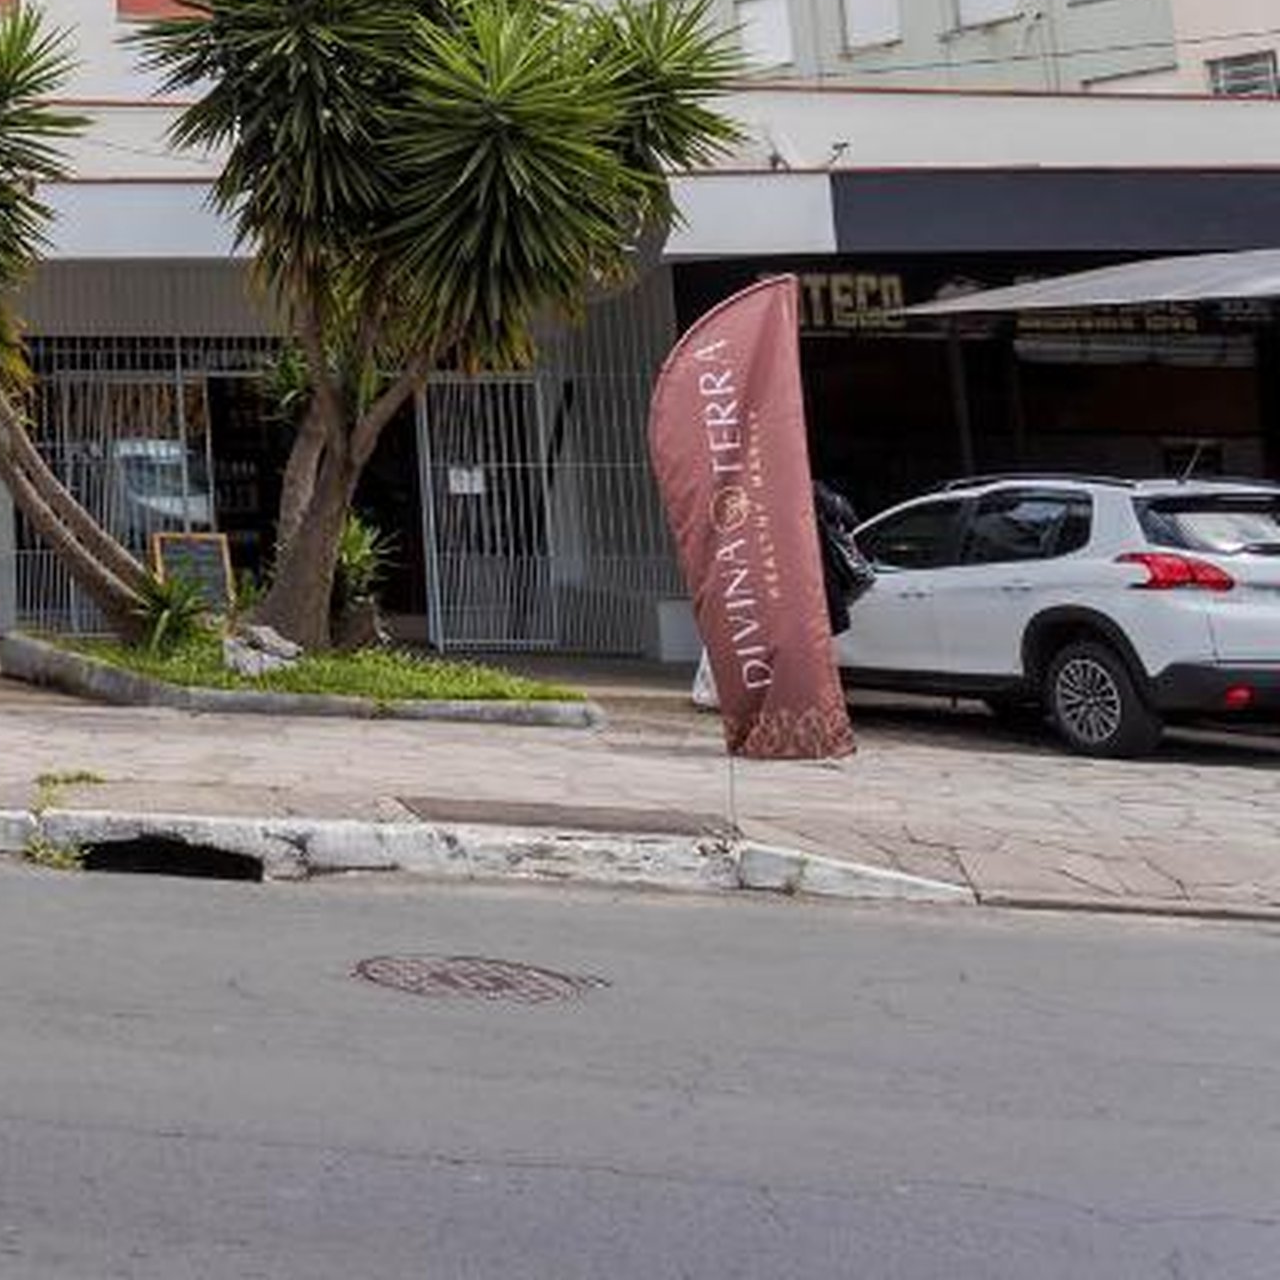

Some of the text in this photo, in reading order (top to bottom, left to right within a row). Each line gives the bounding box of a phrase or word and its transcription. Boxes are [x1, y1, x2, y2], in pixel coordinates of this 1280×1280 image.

[799, 273, 906, 329] TECO
[695, 338, 773, 689] DIVINA TERRA
